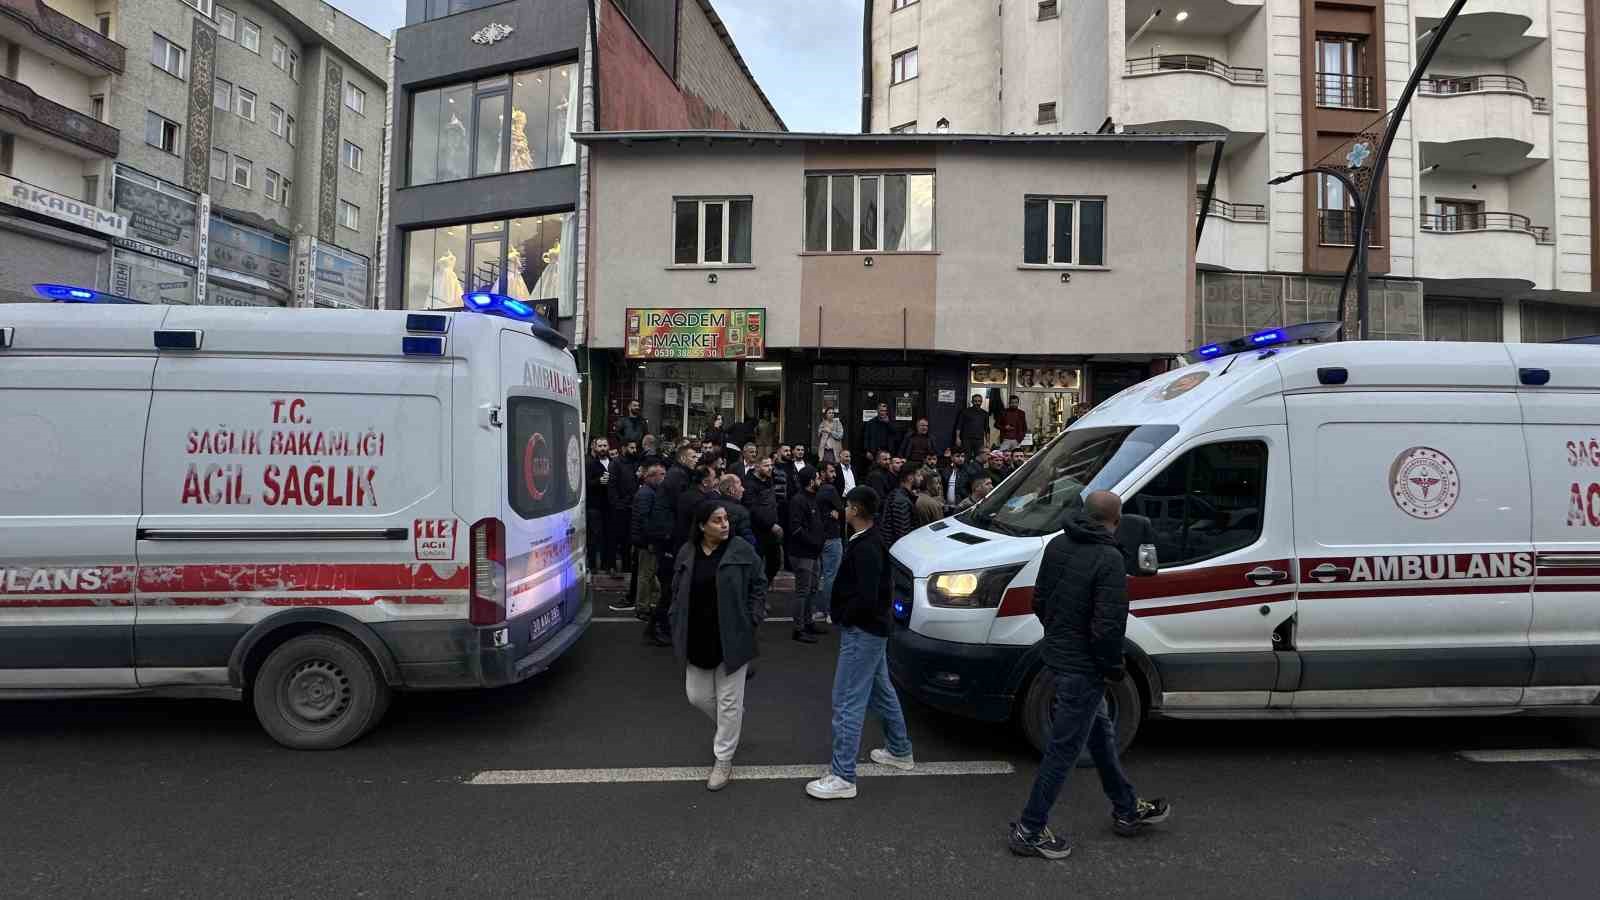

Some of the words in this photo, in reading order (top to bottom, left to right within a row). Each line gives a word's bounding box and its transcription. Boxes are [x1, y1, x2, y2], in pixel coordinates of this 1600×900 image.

[646, 313, 726, 328] IRAQDEM
[653, 333, 719, 347] MARKET
[270, 398, 312, 424] T.C.
[186, 424, 262, 455] SAĞLIK
[269, 427, 384, 456] BAKANLIĞI
[262, 459, 378, 506] SAĞLIK
[1350, 552, 1532, 582] AMBULANS
